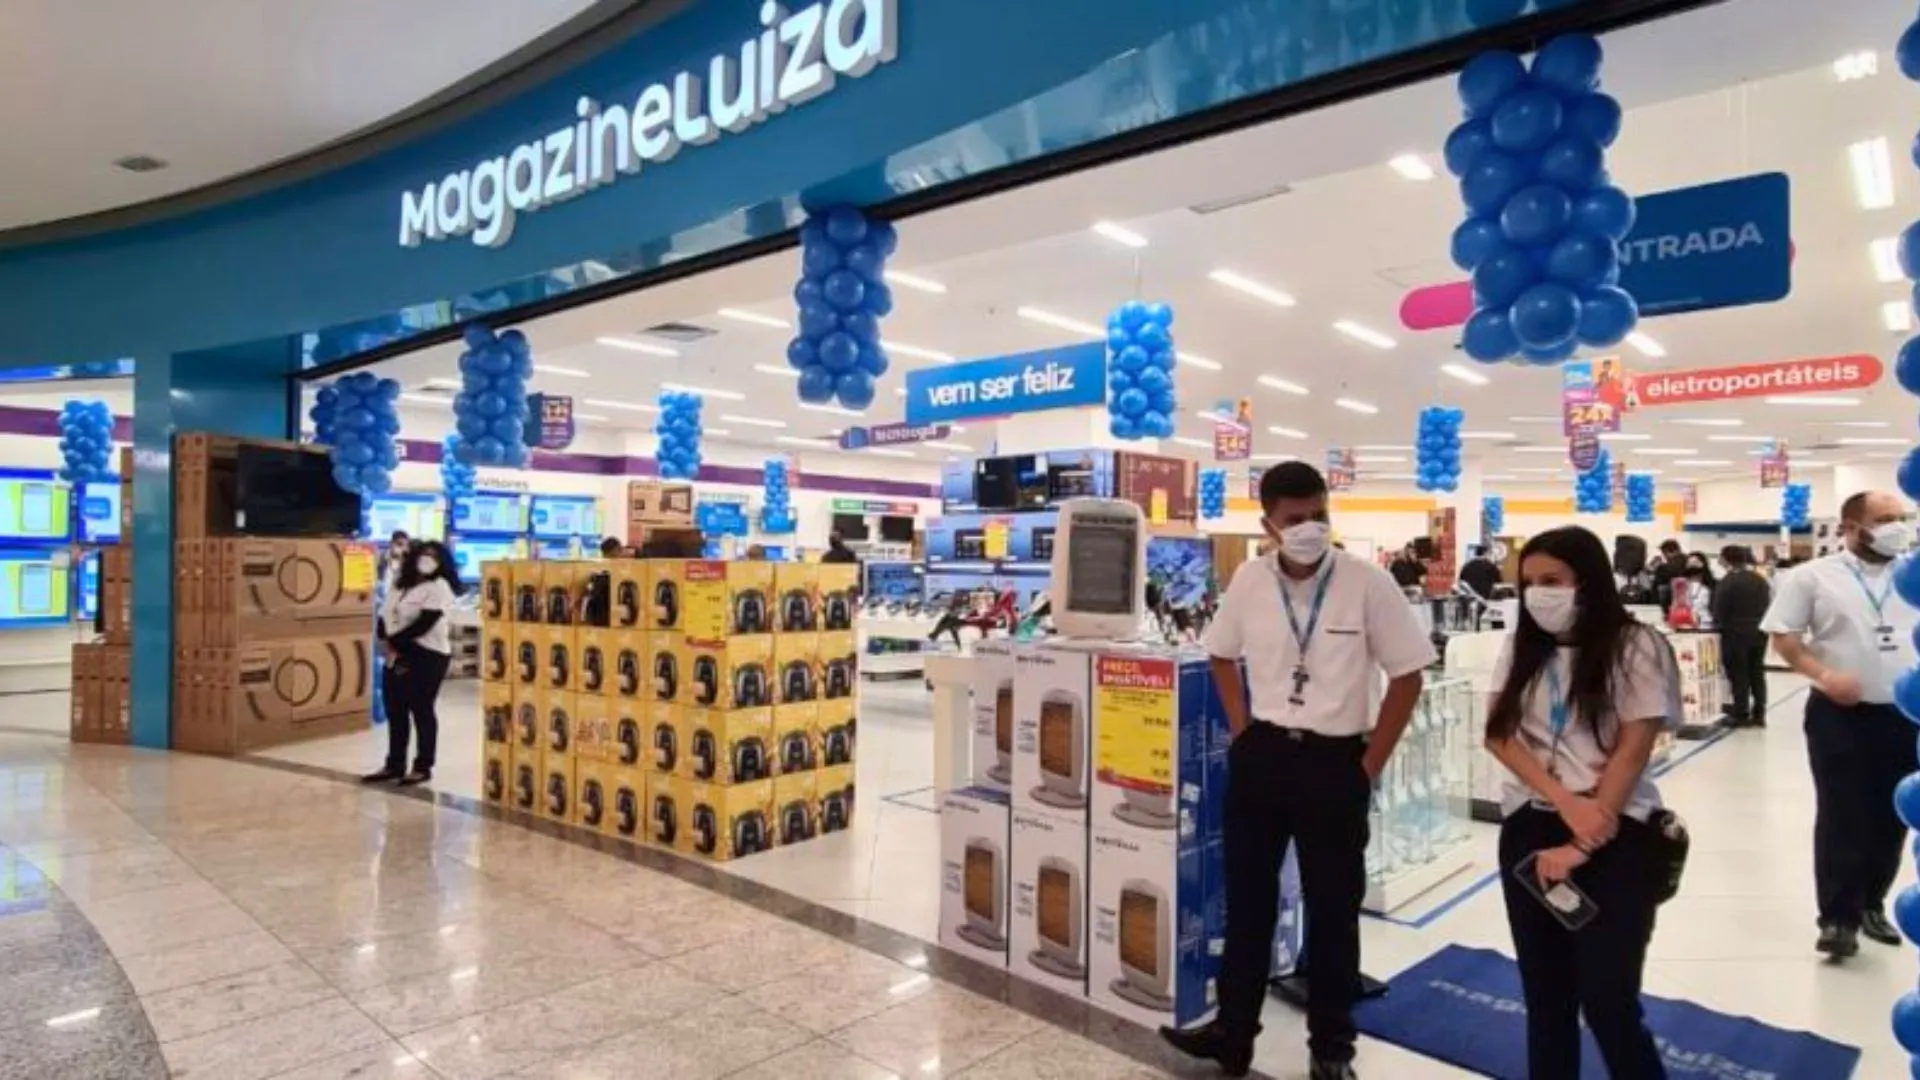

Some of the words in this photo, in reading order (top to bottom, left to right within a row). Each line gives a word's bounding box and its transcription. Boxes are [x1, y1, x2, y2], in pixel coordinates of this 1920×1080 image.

[1617, 221, 1764, 266] NTRADA
[928, 381, 975, 406] vem
[979, 374, 1019, 401] ser
[1023, 361, 1075, 395] feliz
[1647, 361, 1860, 397] eletroportáteis
